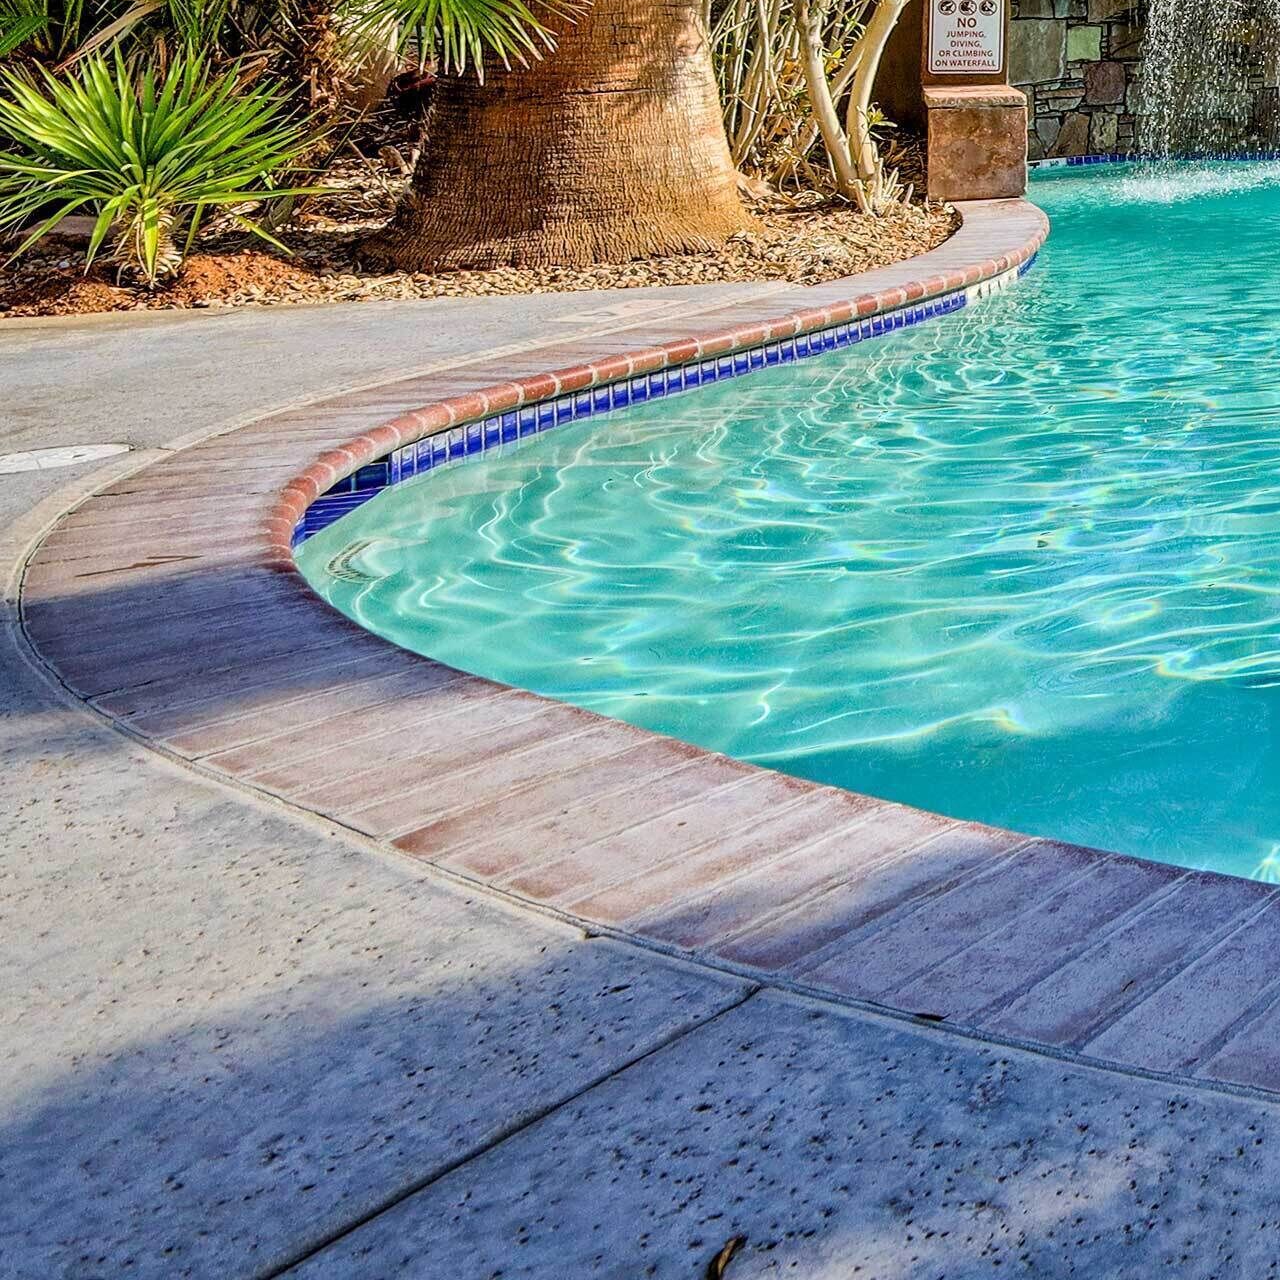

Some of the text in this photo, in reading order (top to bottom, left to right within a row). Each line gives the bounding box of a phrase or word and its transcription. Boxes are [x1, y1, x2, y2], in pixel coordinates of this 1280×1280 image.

[957, 17, 977, 28] NO
[946, 31, 987, 39] JUMPING,
[950, 40, 982, 48] DIVING,
[935, 59, 996, 67] ON WATERFALL
